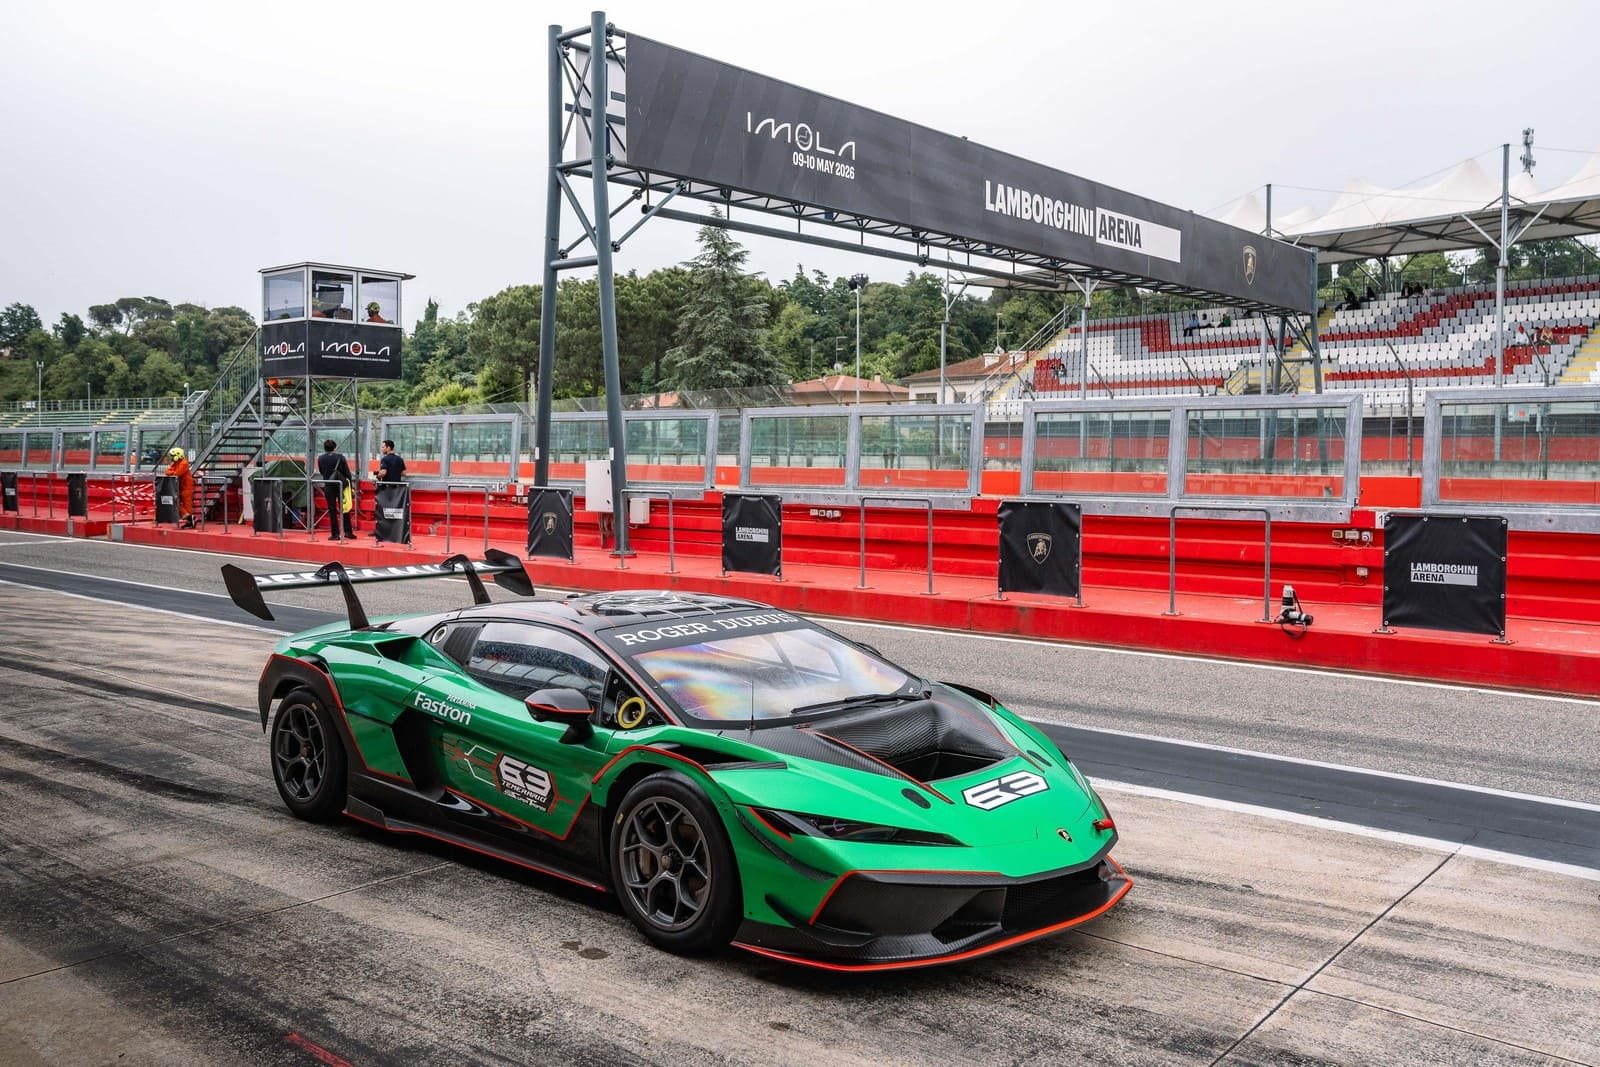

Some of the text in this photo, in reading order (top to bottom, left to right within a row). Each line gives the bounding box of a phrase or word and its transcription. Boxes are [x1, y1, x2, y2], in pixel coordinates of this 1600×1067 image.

[747, 111, 855, 160] IMOLA
[792, 152, 855, 180] 09-10 MAY 2026
[985, 180, 1142, 248] LAMBORGHINI ARENA
[264, 341, 305, 356] IMOLA
[321, 341, 390, 356] IMOLA
[1411, 562, 1478, 575] LAMBORGHINI
[1413, 572, 1445, 582] ARENA
[615, 612, 798, 646] ROGER DUBUIS
[414, 691, 472, 725] Fastron
[499, 755, 551, 797] 63
[963, 770, 1049, 809] 63
